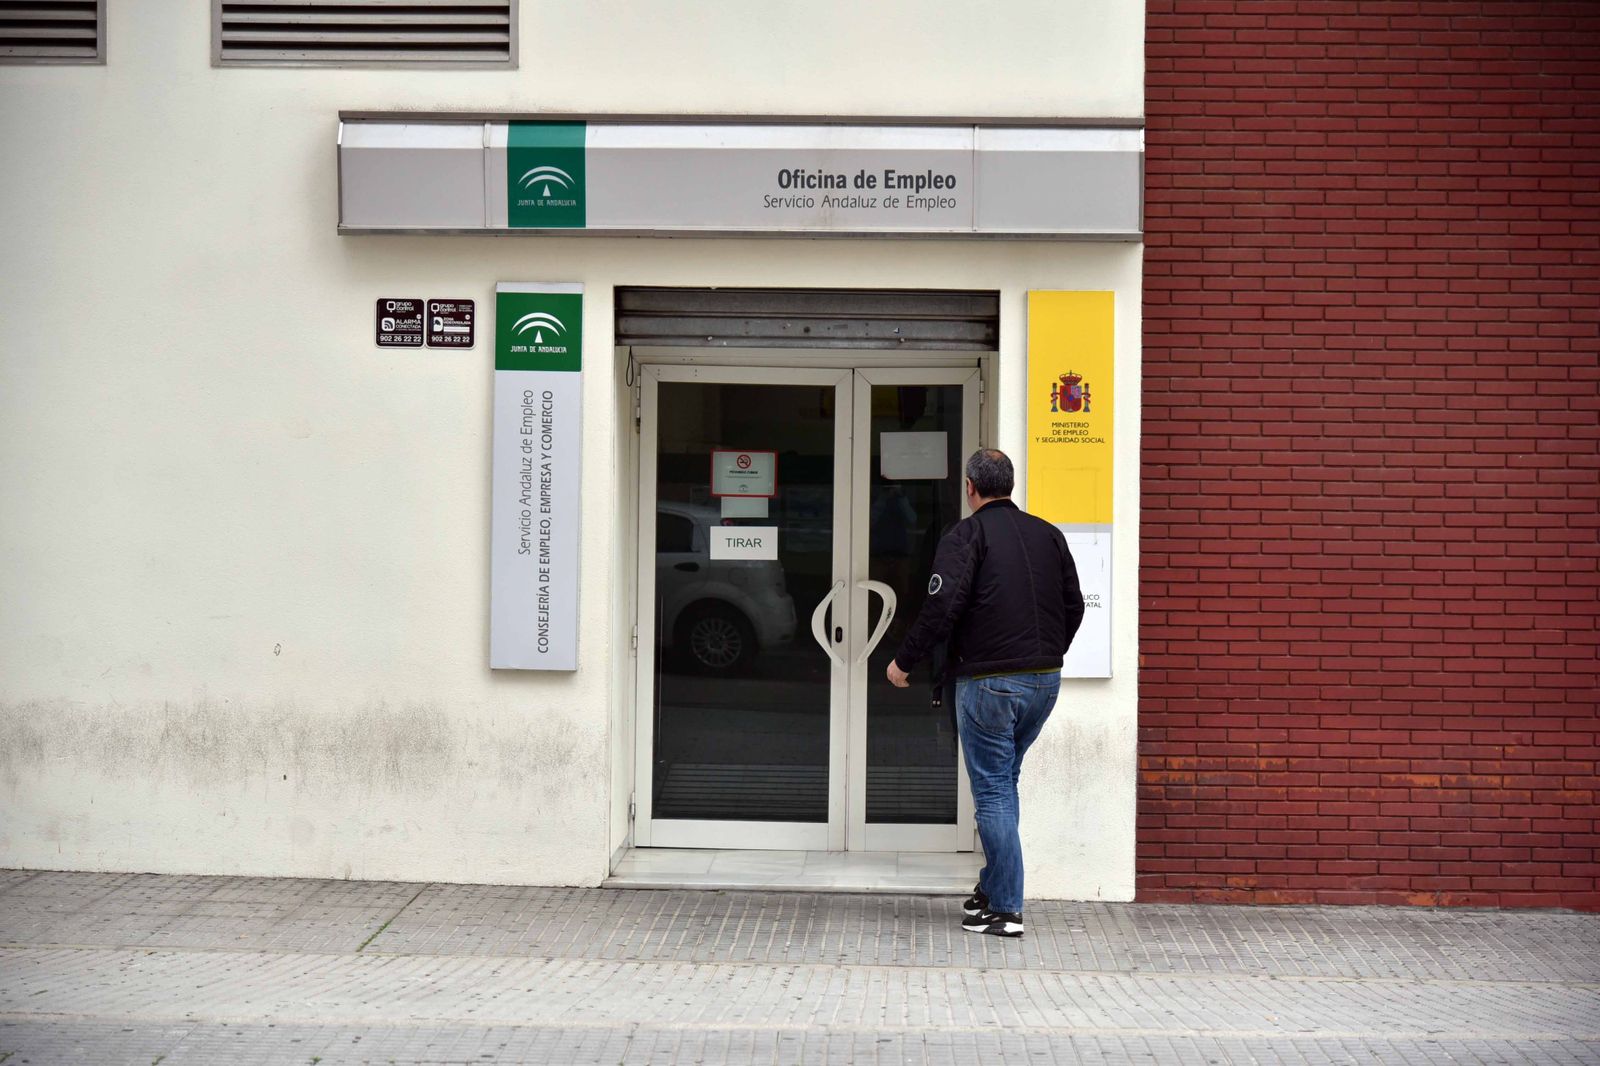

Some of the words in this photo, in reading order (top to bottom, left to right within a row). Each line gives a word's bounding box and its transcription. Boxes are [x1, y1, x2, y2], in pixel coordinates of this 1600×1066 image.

[778, 169, 847, 189] Oficina
[853, 170, 877, 189] de
[884, 170, 956, 194] Empleo
[517, 199, 535, 207] JUNTA
[537, 199, 544, 207] DE
[546, 199, 576, 207] ANDALUCIA
[763, 195, 815, 208] Servicio
[821, 195, 877, 208] Andaluz
[883, 195, 899, 208] de
[906, 195, 957, 212] Empleo
[510, 345, 527, 353] JUNTA
[529, 345, 536, 353] DE
[520, 389, 536, 435] Empleo
[541, 390, 553, 451] COMERCIO
[520, 438, 533, 454] de
[541, 453, 552, 461] Y
[518, 457, 532, 507] Andaluz
[540, 463, 552, 514] EMPRESA
[517, 509, 532, 555] Servicio
[539, 517, 552, 564] EMPLEO,
[725, 538, 762, 548] TIRAR
[539, 567, 550, 582] DE
[536, 585, 549, 654] CONSEJERÍA
